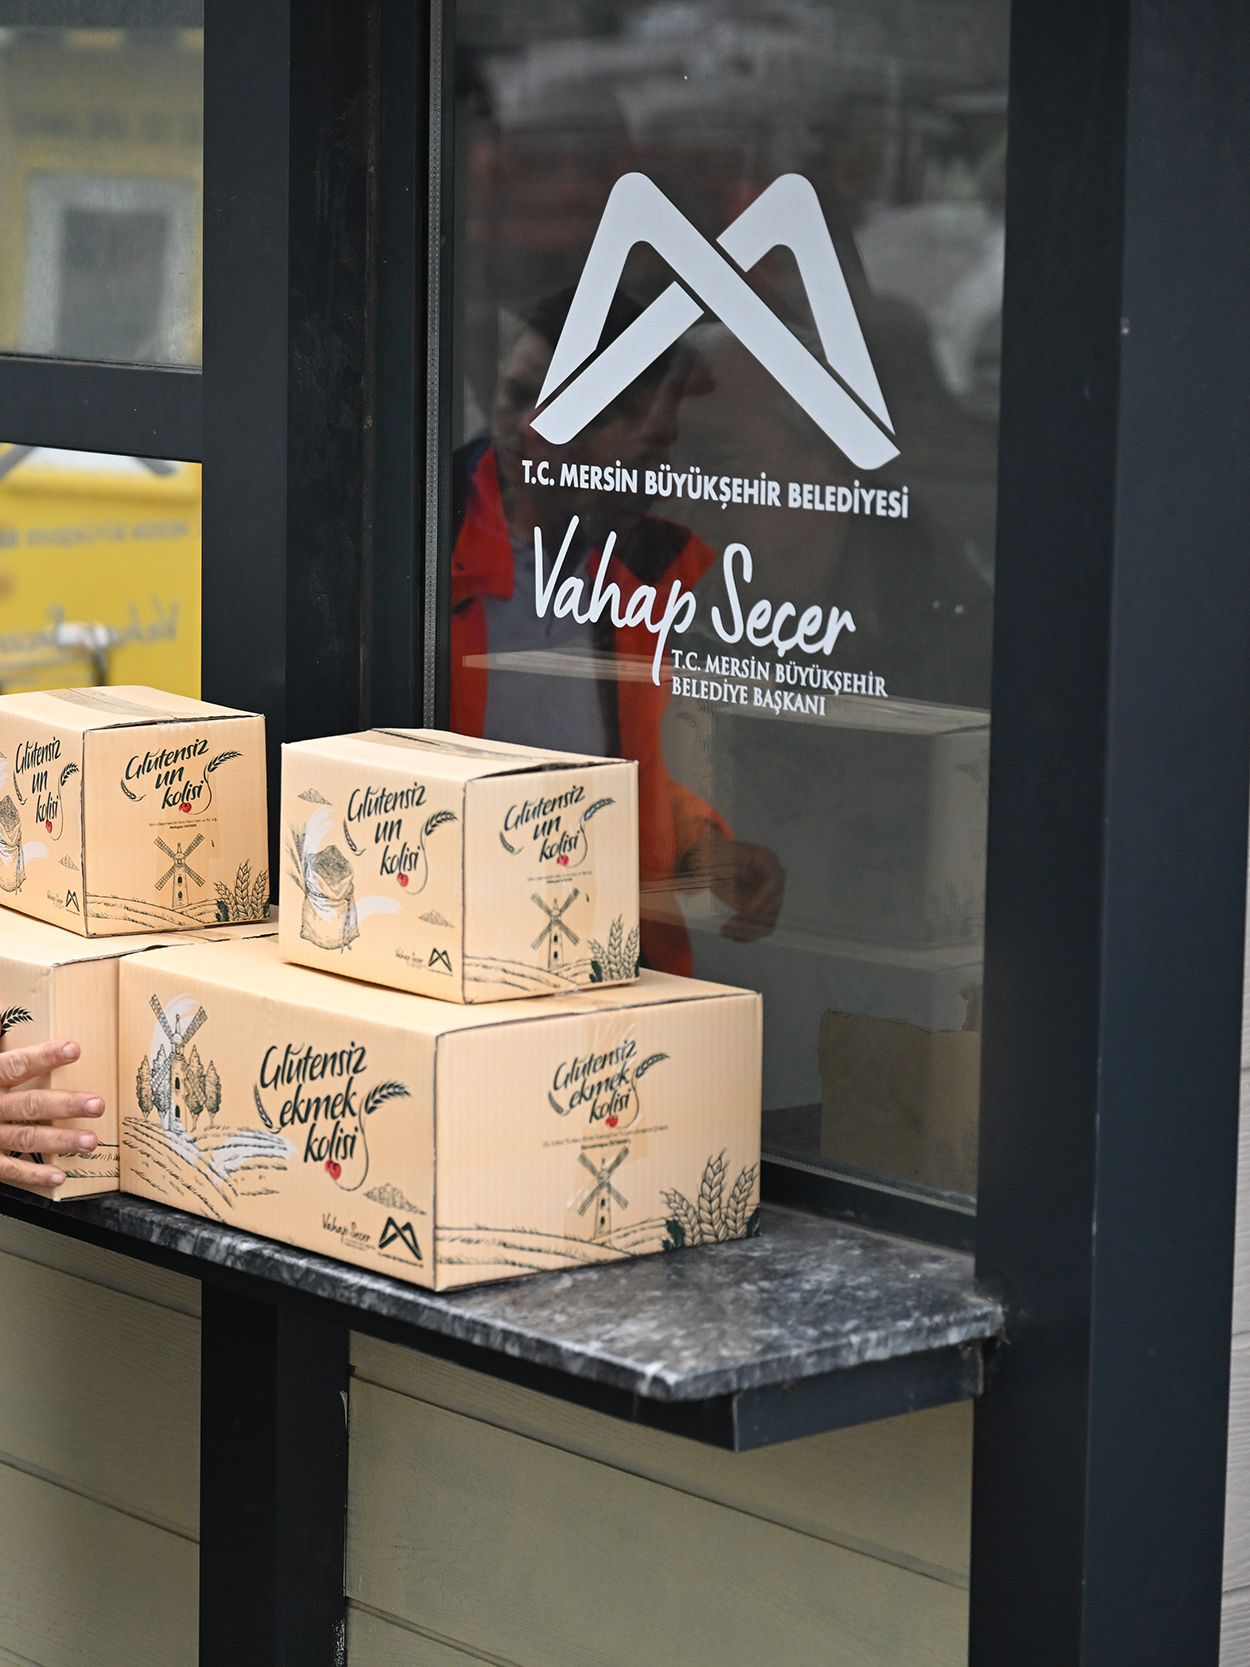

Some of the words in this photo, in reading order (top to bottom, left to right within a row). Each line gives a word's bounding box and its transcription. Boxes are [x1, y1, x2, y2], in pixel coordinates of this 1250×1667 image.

[521, 459, 555, 487] T.C.
[560, 460, 638, 494] MERSİN
[645, 464, 782, 510] BÜYÜKŞEHİR
[788, 480, 910, 519] BELEDİYESİ
[534, 514, 697, 687] Vahap
[711, 542, 856, 657] Seçer
[671, 649, 702, 673] T.C.
[705, 654, 770, 681] MERSİN
[775, 660, 889, 698] BÜYÜKŞEHİR
[671, 676, 749, 706] BELEDİYE
[753, 685, 826, 716] BAŞKANI
[32, 769, 47, 793] un
[155, 767, 184, 789] un
[162, 780, 204, 809] kolisi
[36, 792, 59, 823] kolisi
[375, 819, 401, 844] un
[533, 815, 561, 840] un
[380, 842, 423, 875] kolisi
[539, 830, 583, 862] kolisi
[279, 1077, 357, 1127] ekmek
[569, 1063, 630, 1109] ekmek
[589, 1088, 631, 1123] kolisi
[304, 1121, 360, 1163] kolisi
